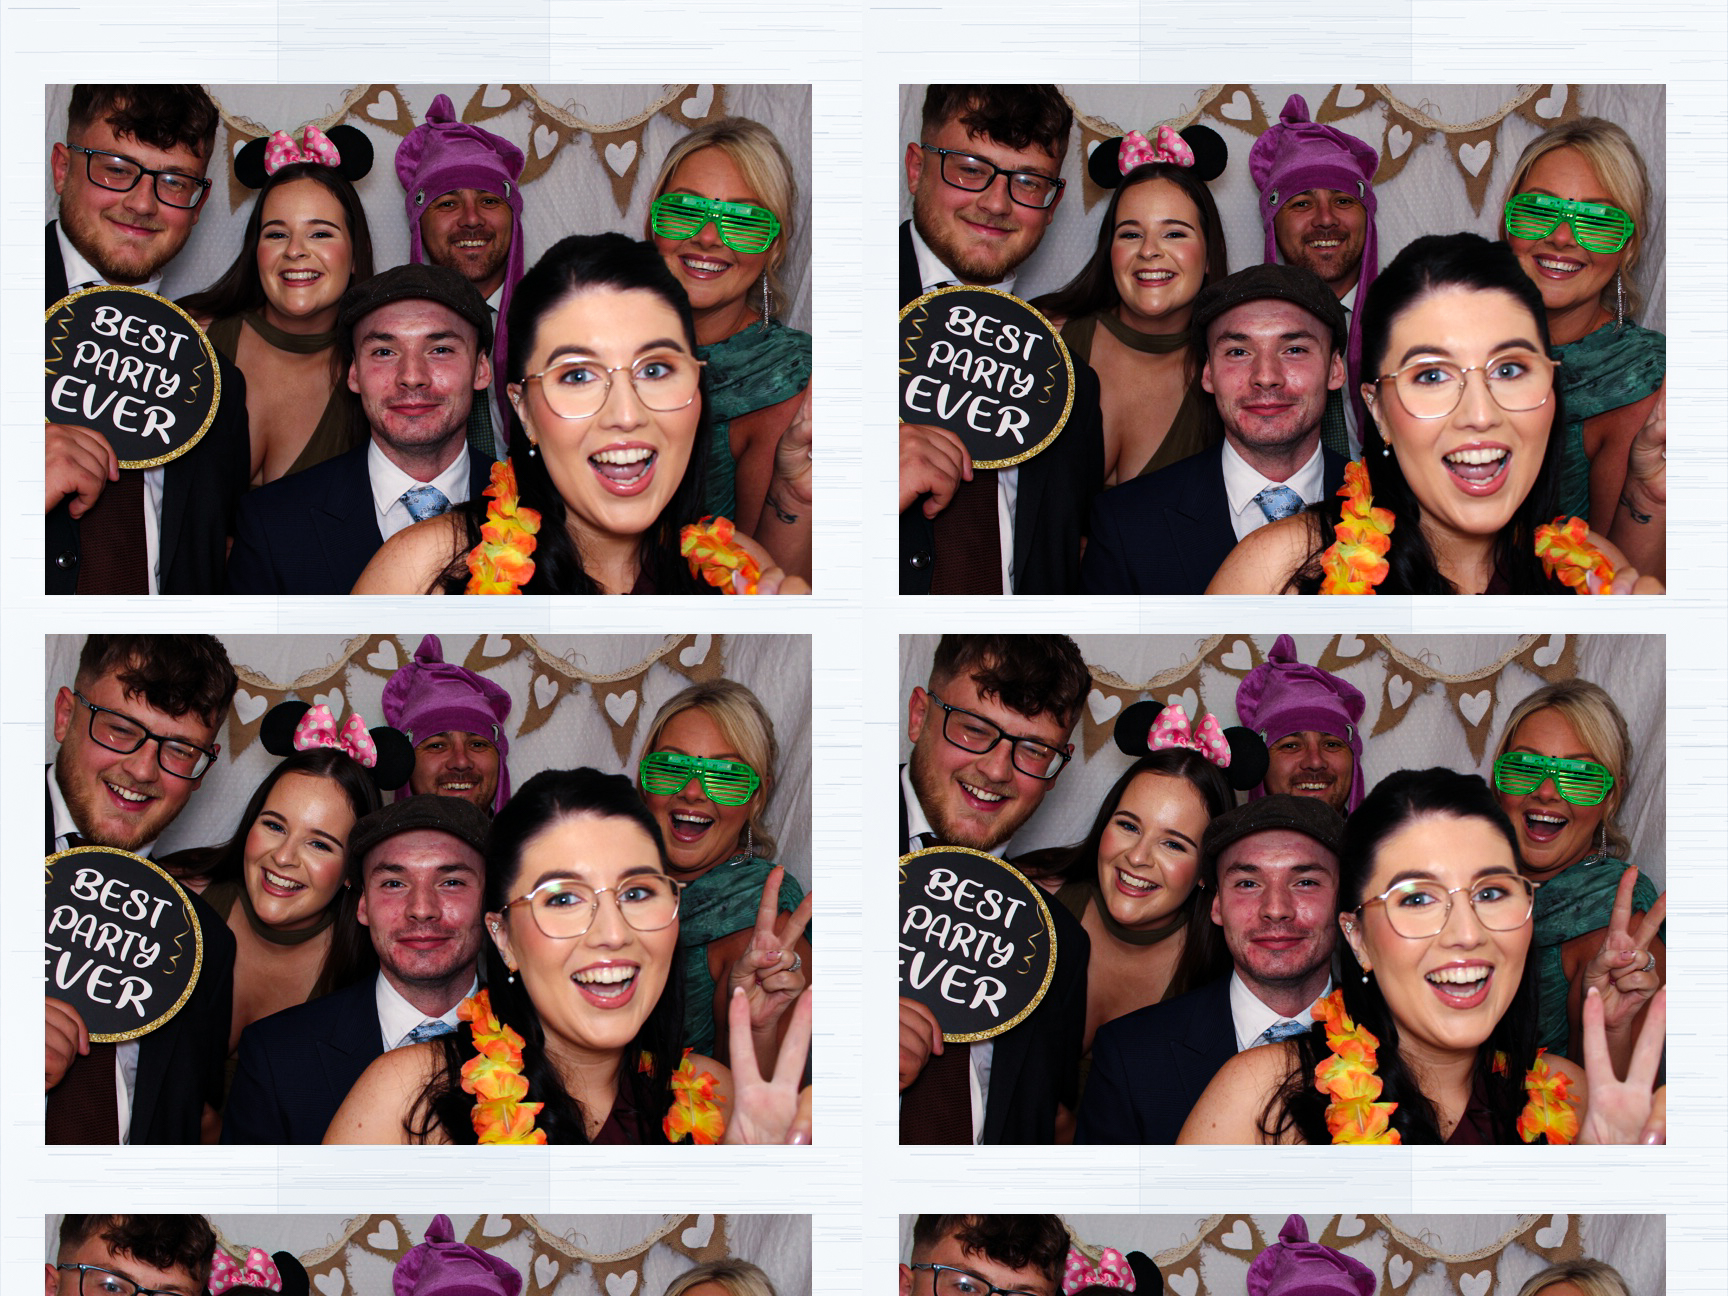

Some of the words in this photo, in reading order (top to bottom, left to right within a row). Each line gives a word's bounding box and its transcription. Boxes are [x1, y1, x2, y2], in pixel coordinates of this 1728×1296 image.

[90, 305, 189, 361] BEST
[944, 305, 1043, 361] BEST
[73, 340, 181, 399] PARTY
[927, 340, 1035, 399] PARTY
[51, 374, 176, 445] EVER
[905, 374, 1030, 445] EVER
[70, 868, 173, 929] BEST
[924, 868, 1027, 929] BEST
[48, 904, 161, 969] PARTY
[902, 904, 1015, 969] PARTY
